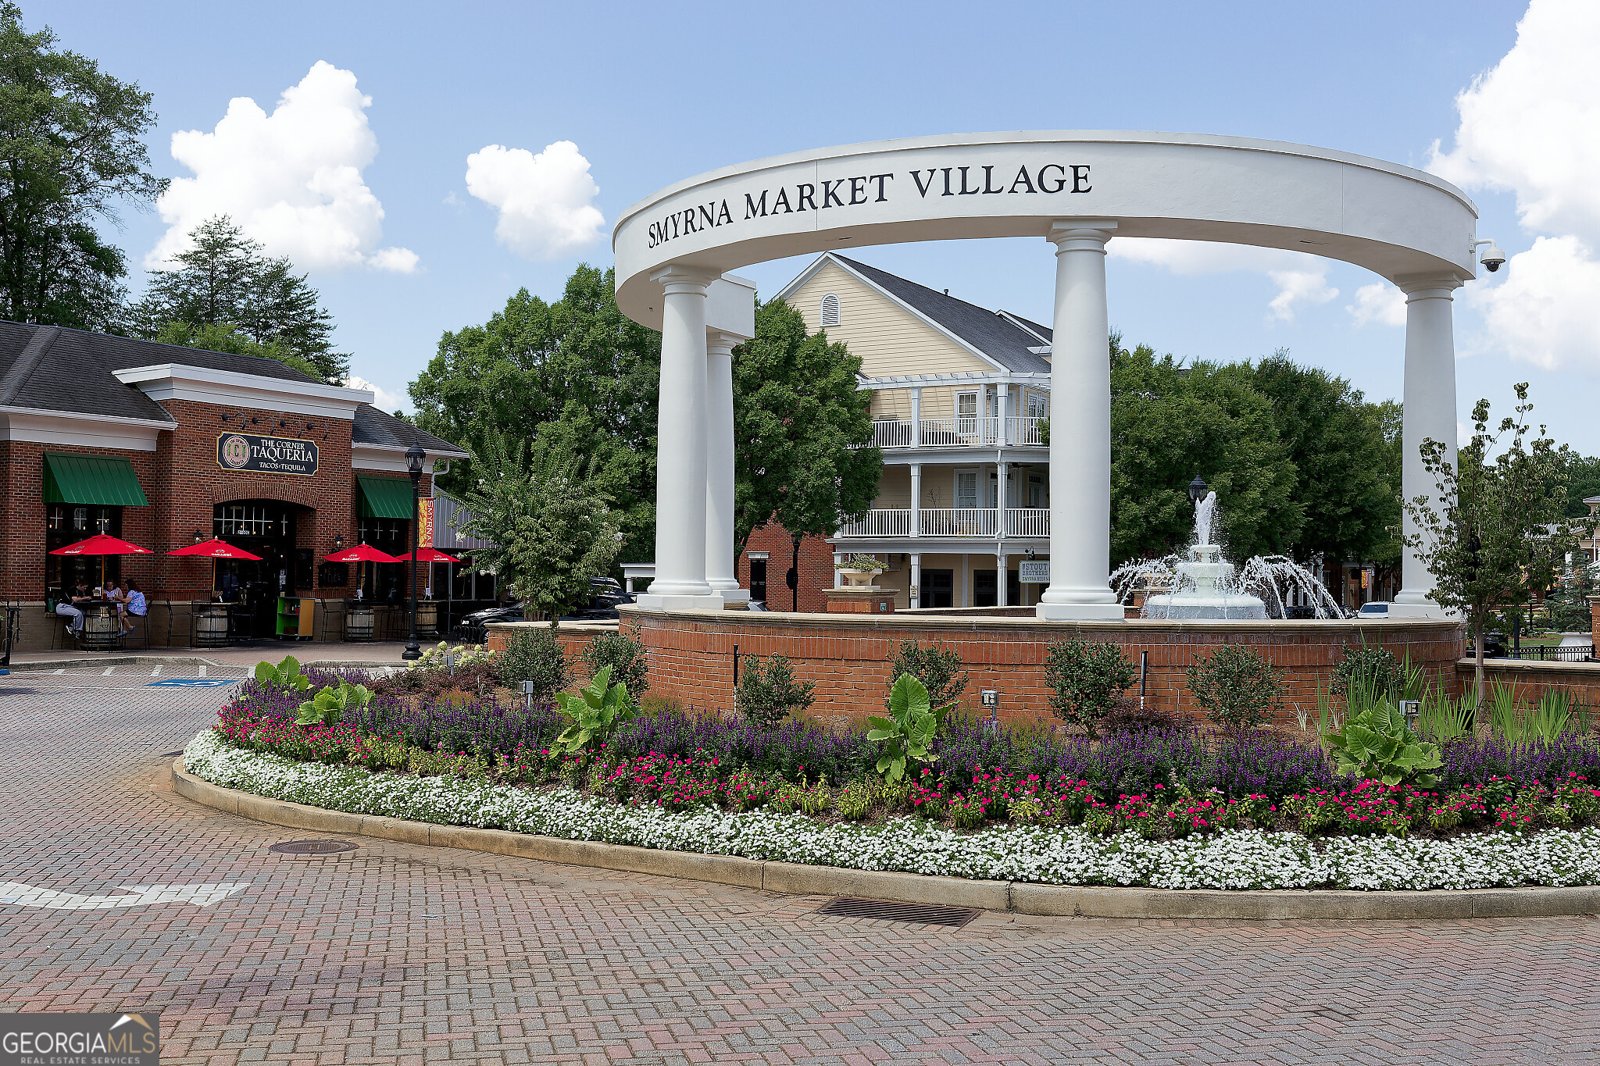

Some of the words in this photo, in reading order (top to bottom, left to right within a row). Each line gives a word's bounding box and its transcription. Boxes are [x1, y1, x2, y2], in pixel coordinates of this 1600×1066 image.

[648, 199, 733, 249] SMYRNA
[744, 173, 894, 220] MARKET
[909, 164, 1093, 198] VILLAGE
[261, 439, 275, 447] THE
[278, 441, 305, 450] CORNER
[251, 445, 313, 462] TAQUERIA
[259, 462, 278, 470] TACOS
[426, 500, 434, 542] SMYRNA
